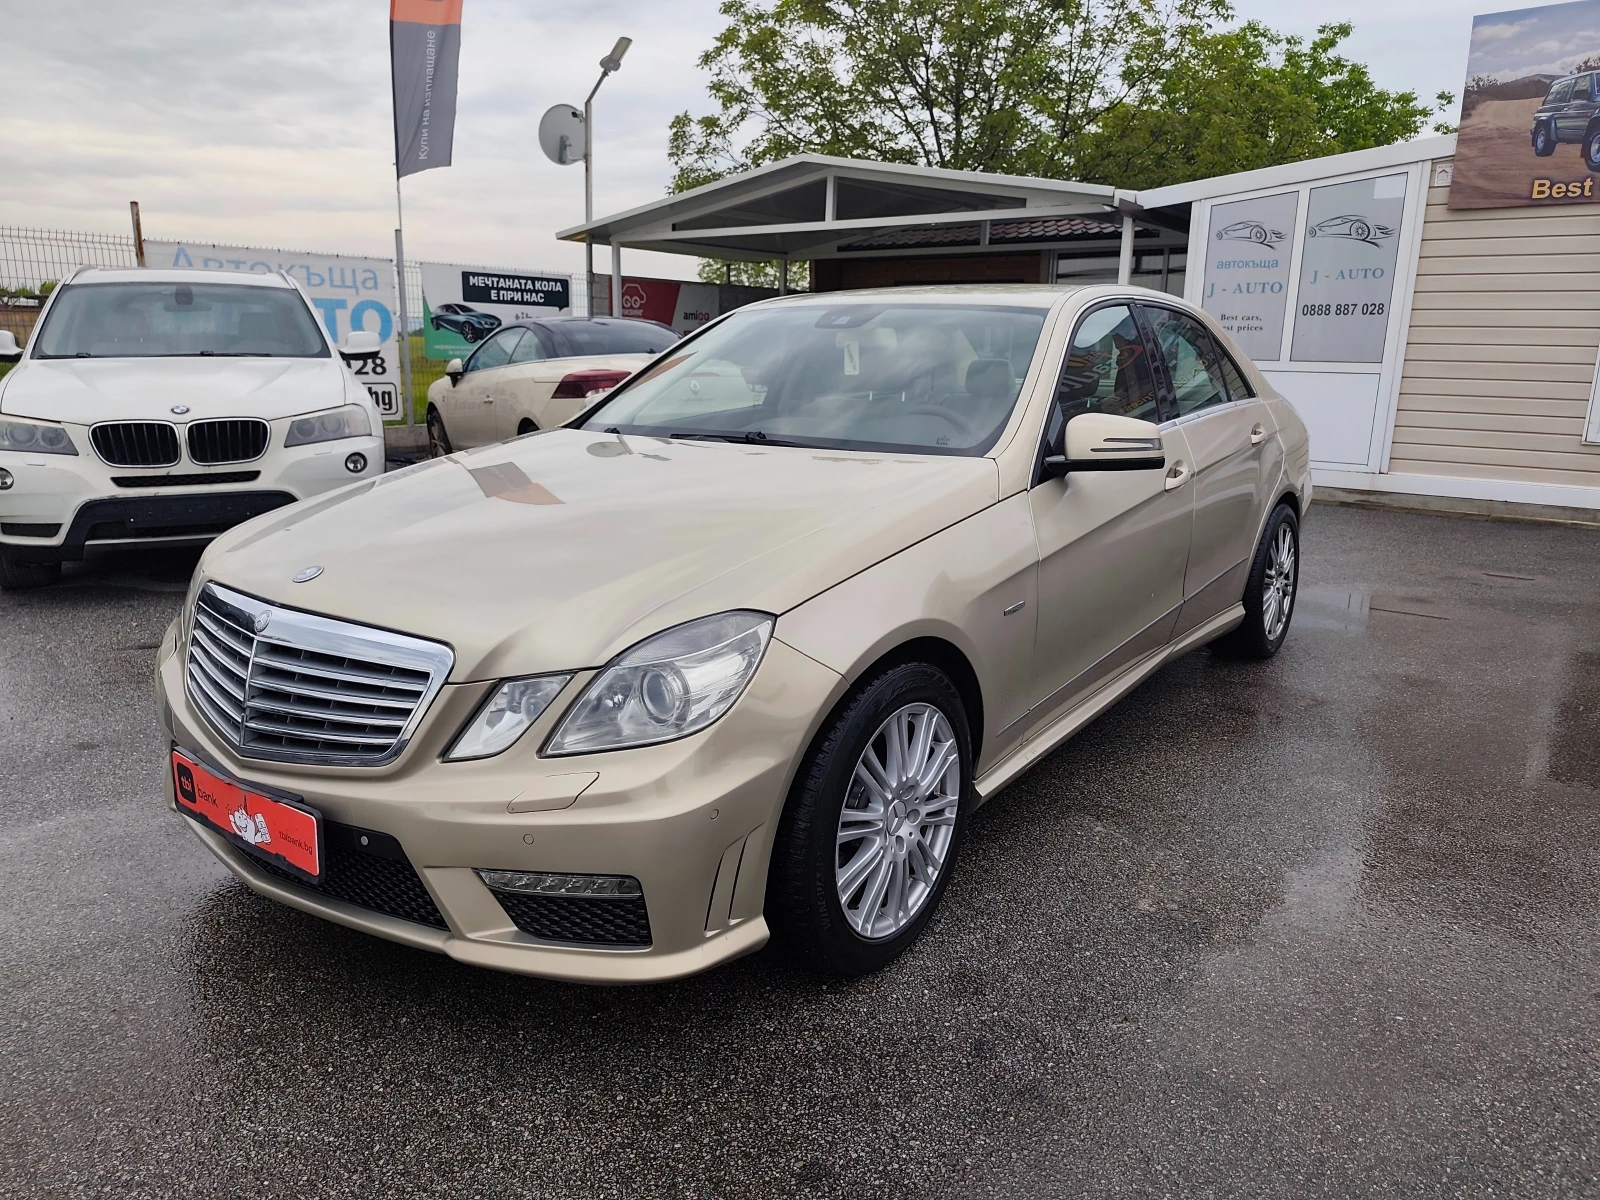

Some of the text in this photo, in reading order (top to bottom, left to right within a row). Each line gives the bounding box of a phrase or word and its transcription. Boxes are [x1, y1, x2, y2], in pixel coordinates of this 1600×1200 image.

[418, 30, 436, 160] Купи на изплащане
[1531, 177, 1594, 199] Best
[1216, 259, 1279, 270] автокъща
[469, 275, 563, 292] МЕЧТАНАТА КОЛА
[1310, 270, 1318, 284] J
[1336, 267, 1385, 280] AUTO
[490, 290, 545, 303] Е ПРИ НАС
[1207, 282, 1215, 298] J
[1233, 281, 1283, 294] AUTO
[1220, 313, 1238, 321] Best
[1302, 303, 1385, 316] 0888 887 028
[1237, 323, 1263, 333] prices
[344, 356, 387, 375] 28
[181, 775, 219, 808] tbi bank
[278, 830, 313, 856] tbibank.bg
